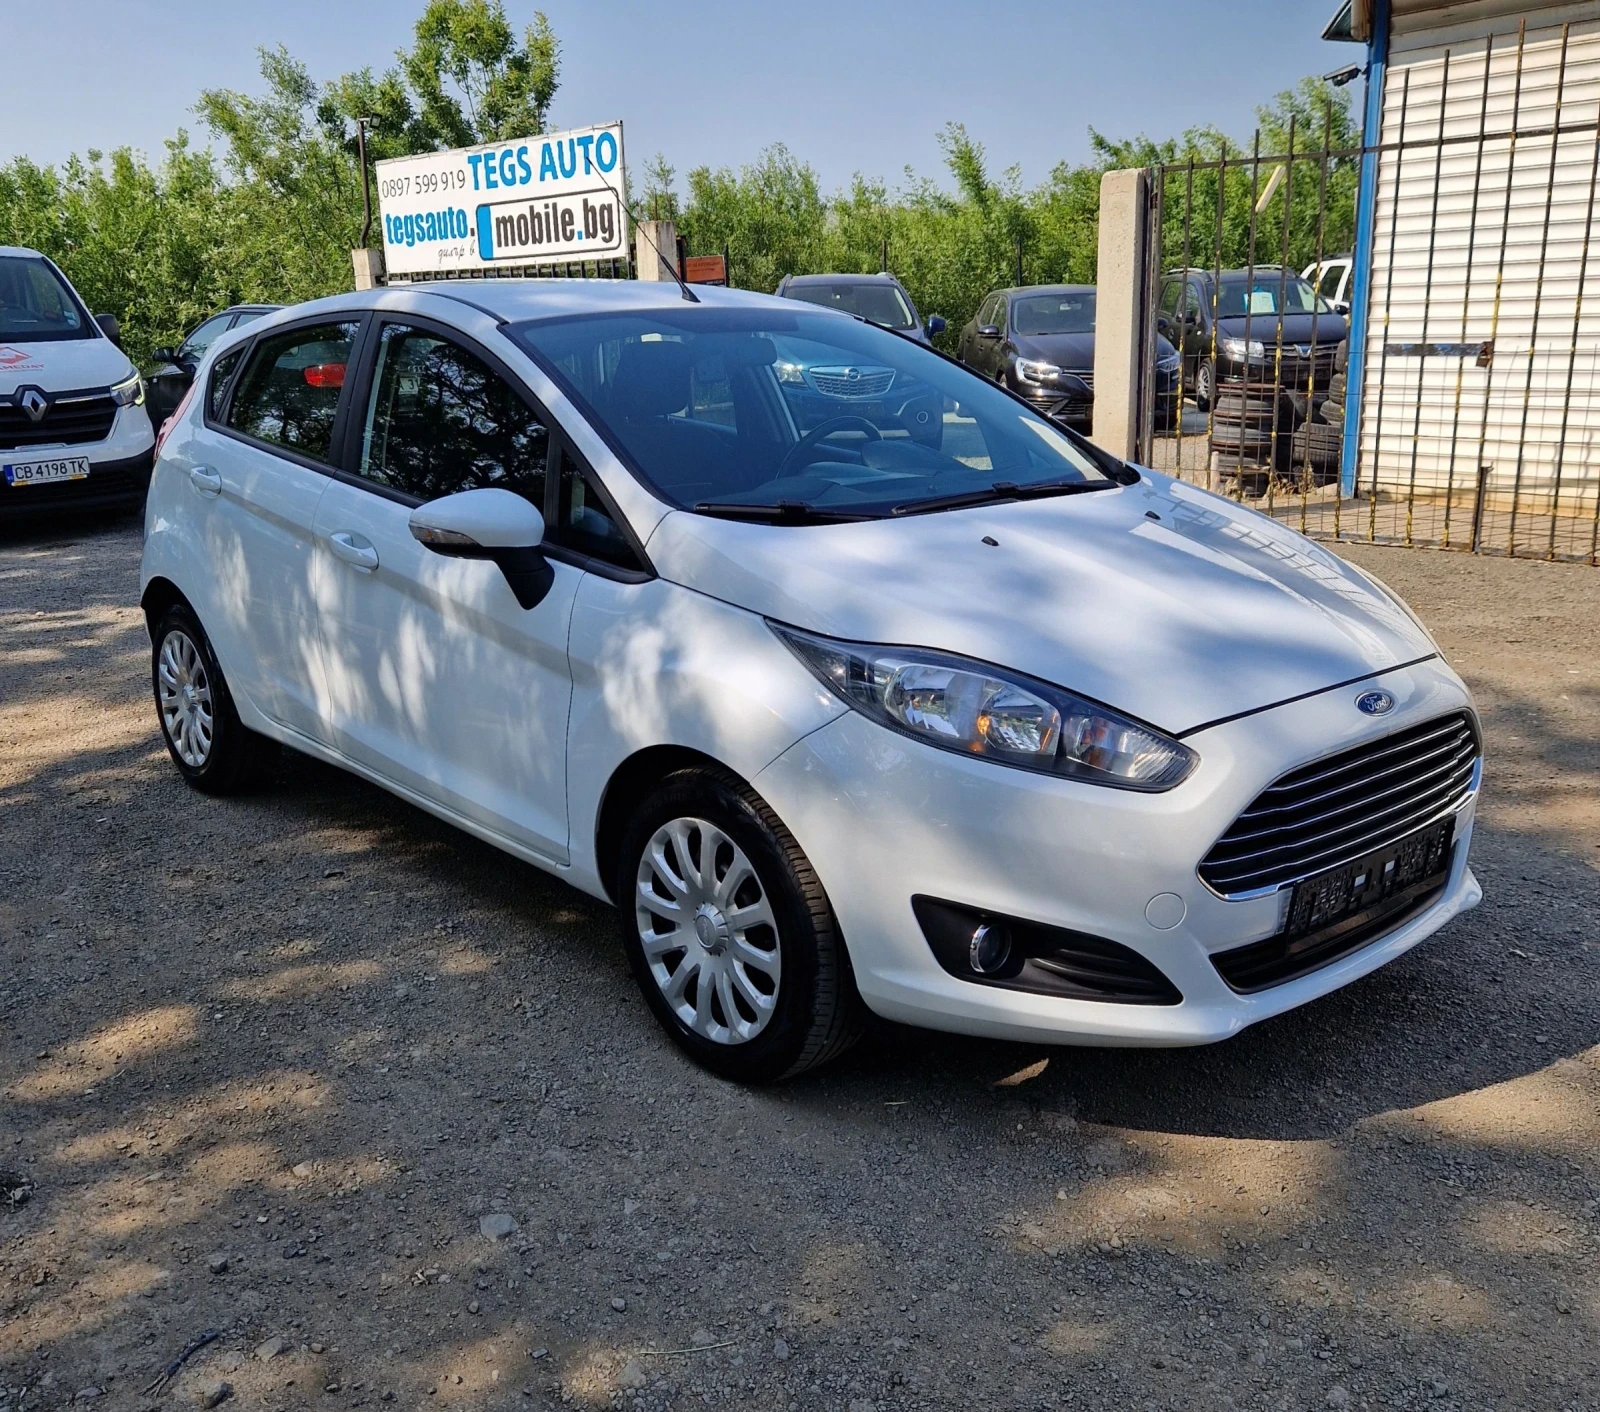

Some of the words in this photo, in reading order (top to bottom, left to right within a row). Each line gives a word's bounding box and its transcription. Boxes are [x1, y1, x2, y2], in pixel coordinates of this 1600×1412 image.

[467, 146, 532, 190] TEGS
[539, 131, 617, 182] AUTO
[381, 177, 410, 198] 0897
[415, 173, 438, 194] 599
[441, 169, 466, 191] 919
[495, 198, 615, 248] mobile.bg
[15, 466, 33, 479] CB
[36, 462, 68, 477] 4198
[69, 460, 87, 473] TK
[1364, 695, 1387, 712] Ford
